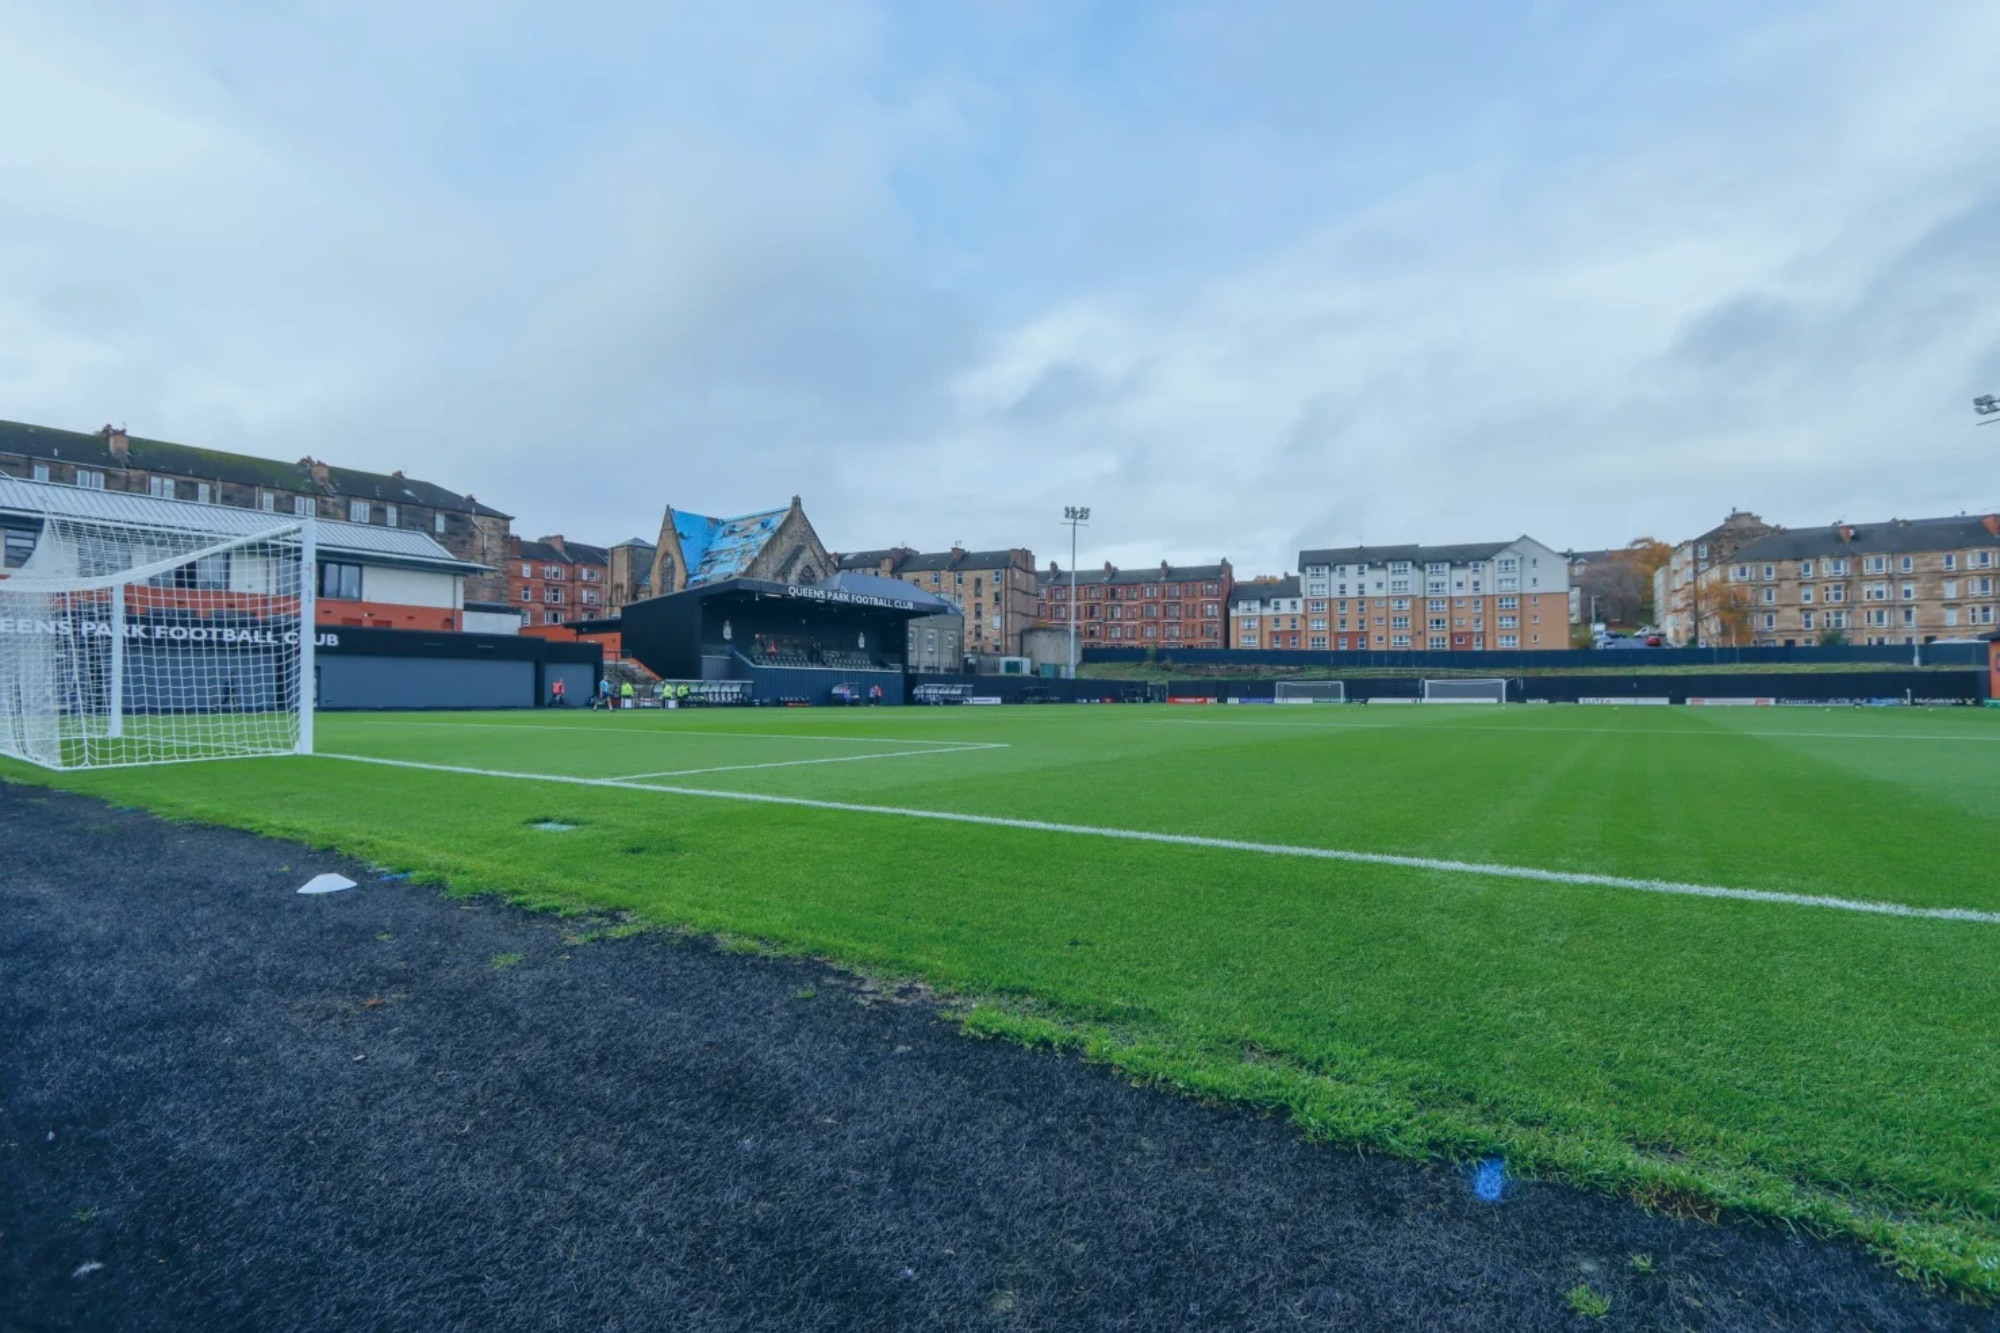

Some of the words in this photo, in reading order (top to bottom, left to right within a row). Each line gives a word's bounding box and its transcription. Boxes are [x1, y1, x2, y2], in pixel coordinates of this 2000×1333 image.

[787, 586, 825, 599] QUEENS
[827, 591, 850, 602] PARK
[851, 594, 893, 608] FOOTBALL
[894, 599, 914, 610] CLUB
[155, 625, 278, 644] FOOTBALL
[284, 632, 339, 646] CUB
